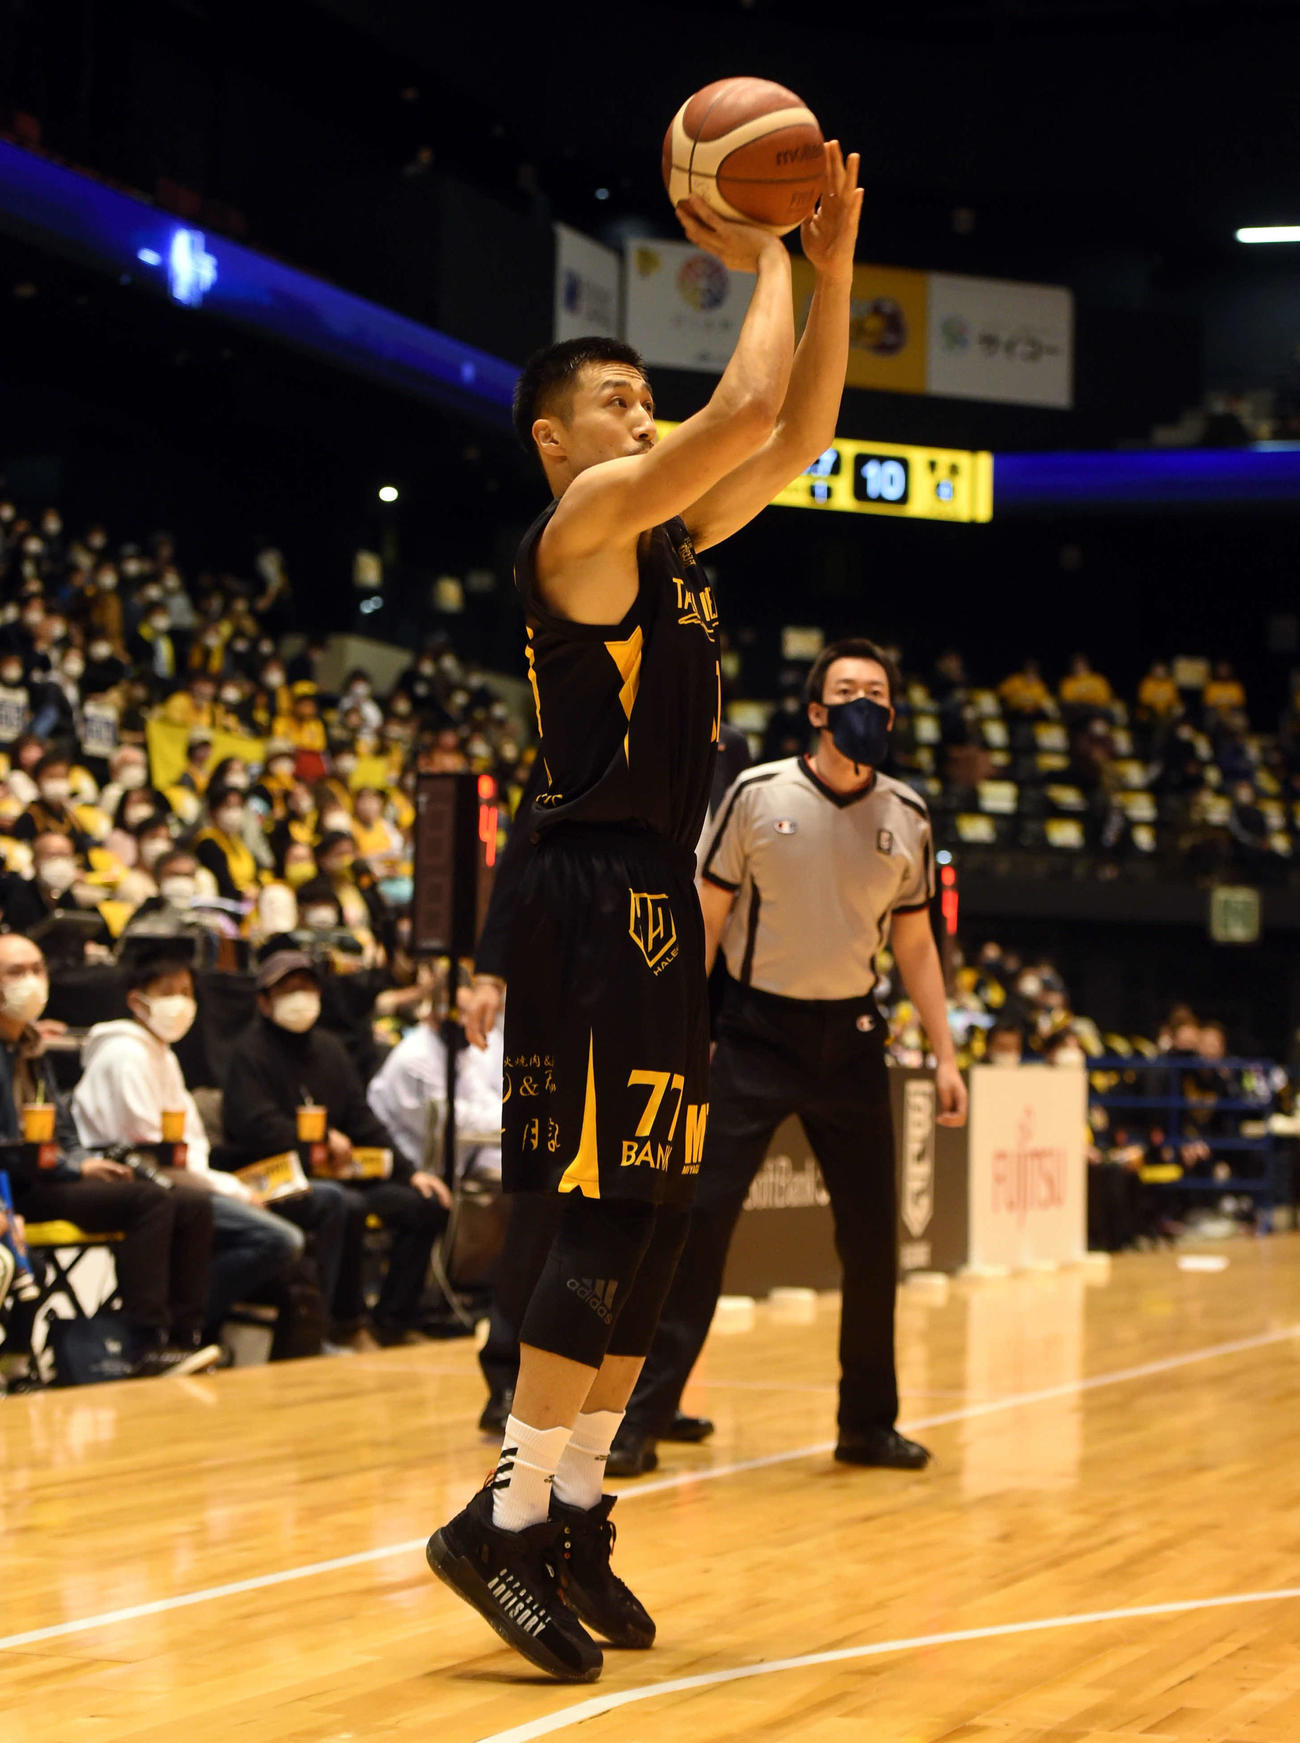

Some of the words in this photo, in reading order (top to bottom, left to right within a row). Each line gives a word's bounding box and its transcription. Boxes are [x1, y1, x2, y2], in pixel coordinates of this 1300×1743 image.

[860, 458, 907, 501] 10
[626, 1069, 685, 1142] 77
[566, 1279, 612, 1325] adidas
[487, 1576, 546, 1637] ADVISORY
